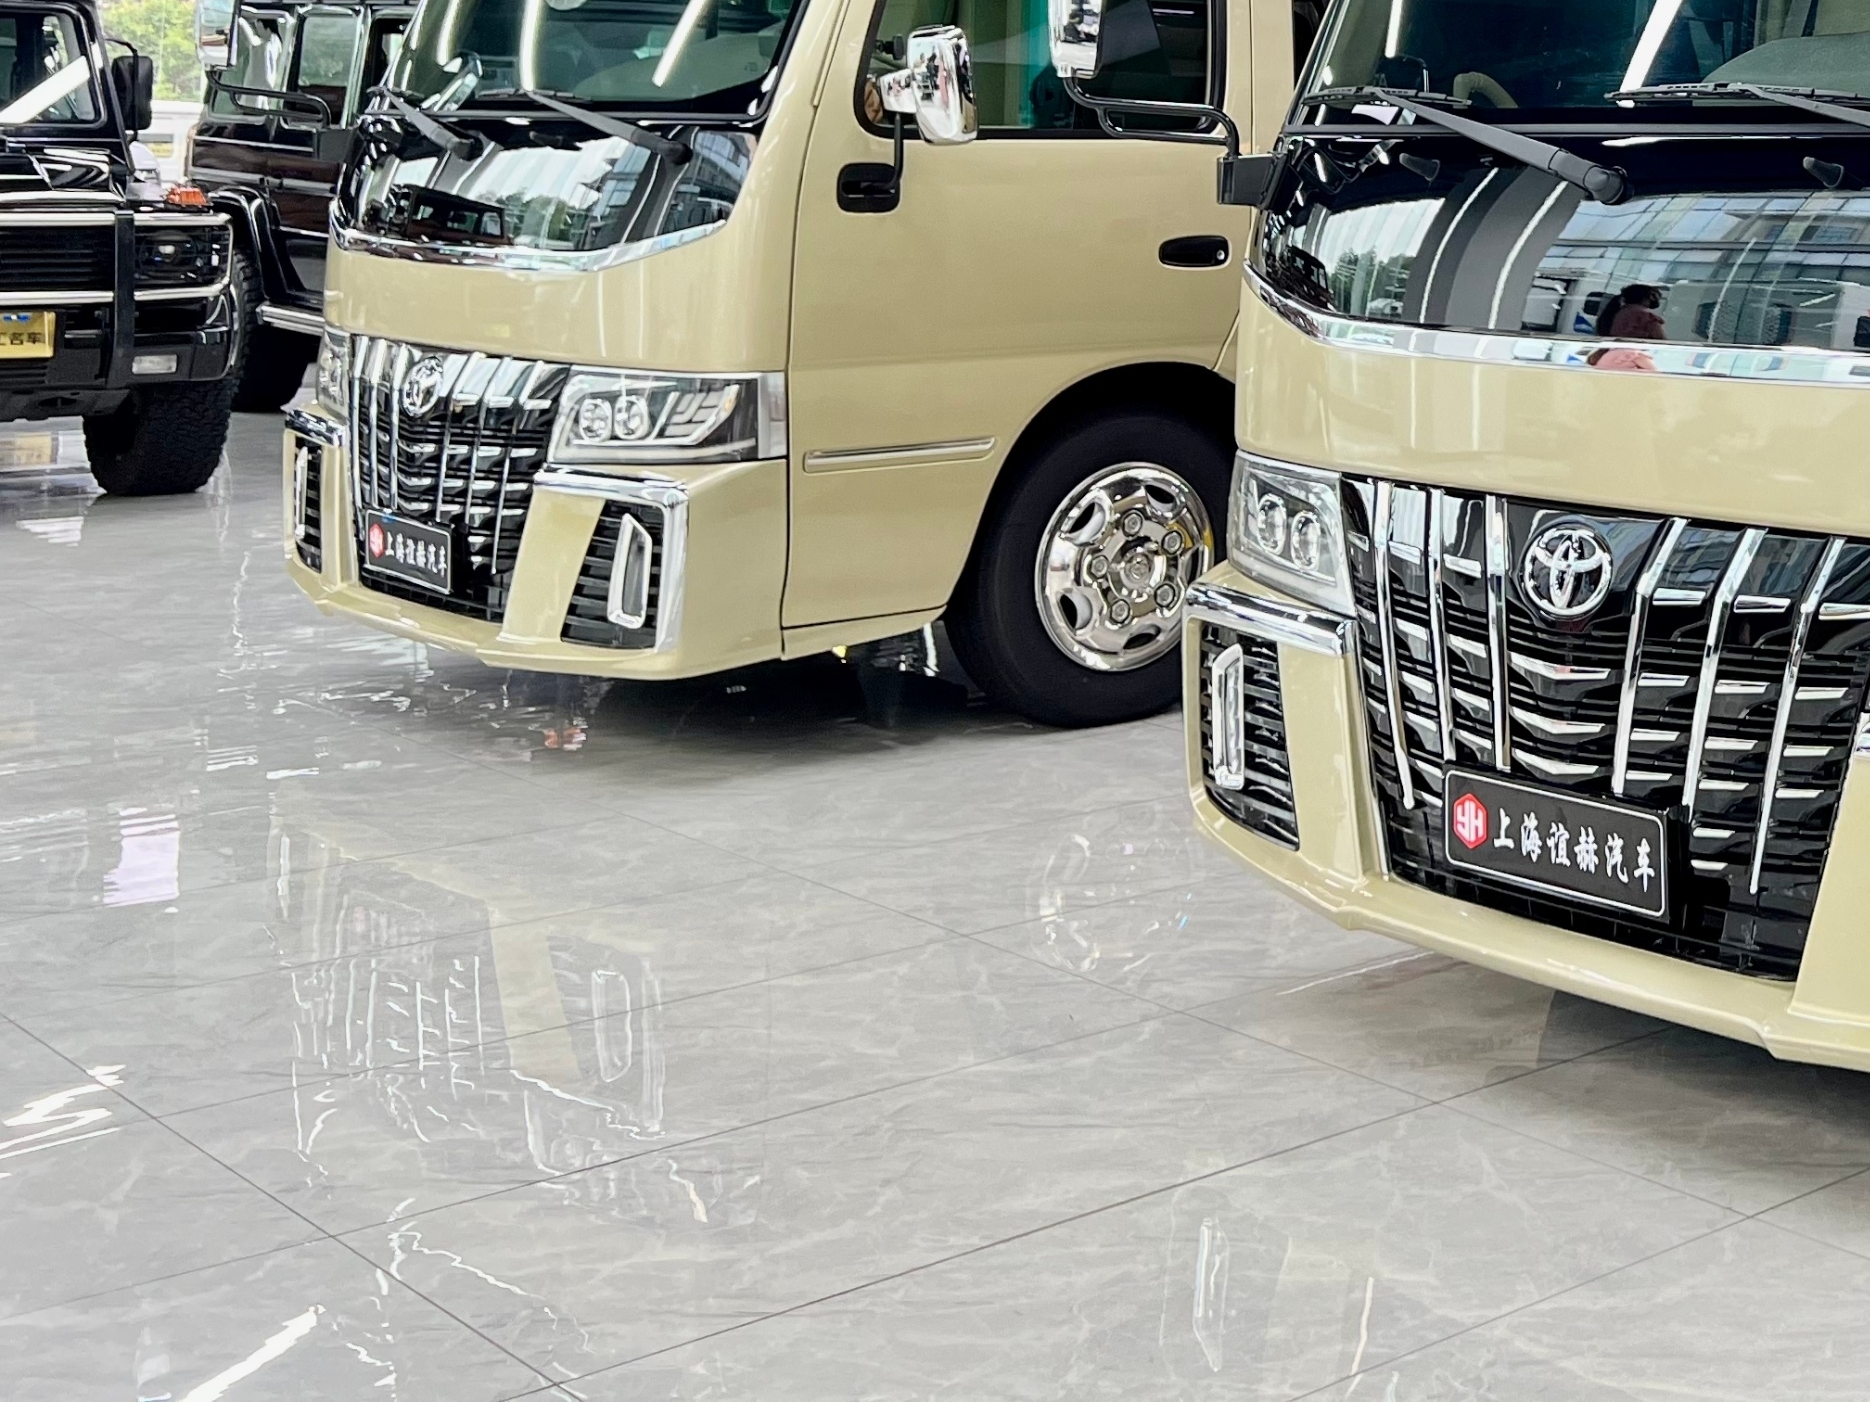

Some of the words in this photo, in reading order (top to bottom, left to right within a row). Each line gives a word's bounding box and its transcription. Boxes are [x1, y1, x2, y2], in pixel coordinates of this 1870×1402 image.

[1493, 807, 1656, 893] 上海谊赫汽车
